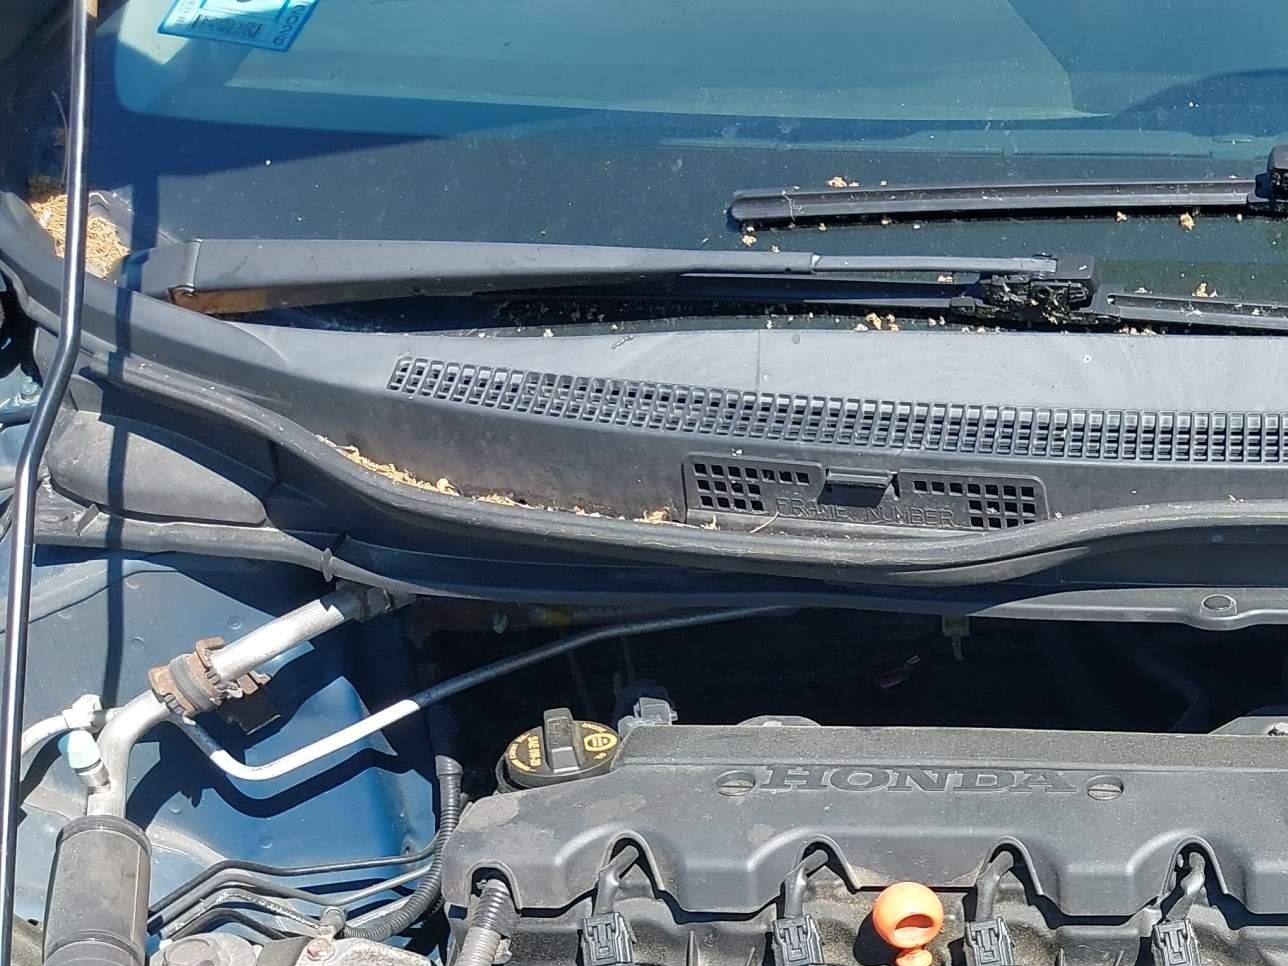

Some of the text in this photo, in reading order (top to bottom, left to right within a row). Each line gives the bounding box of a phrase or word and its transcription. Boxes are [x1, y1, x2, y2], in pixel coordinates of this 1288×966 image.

[272, 5, 306, 46] 2026
[776, 497, 955, 528] FRAME NUMBER
[759, 764, 1079, 793] HONDA
